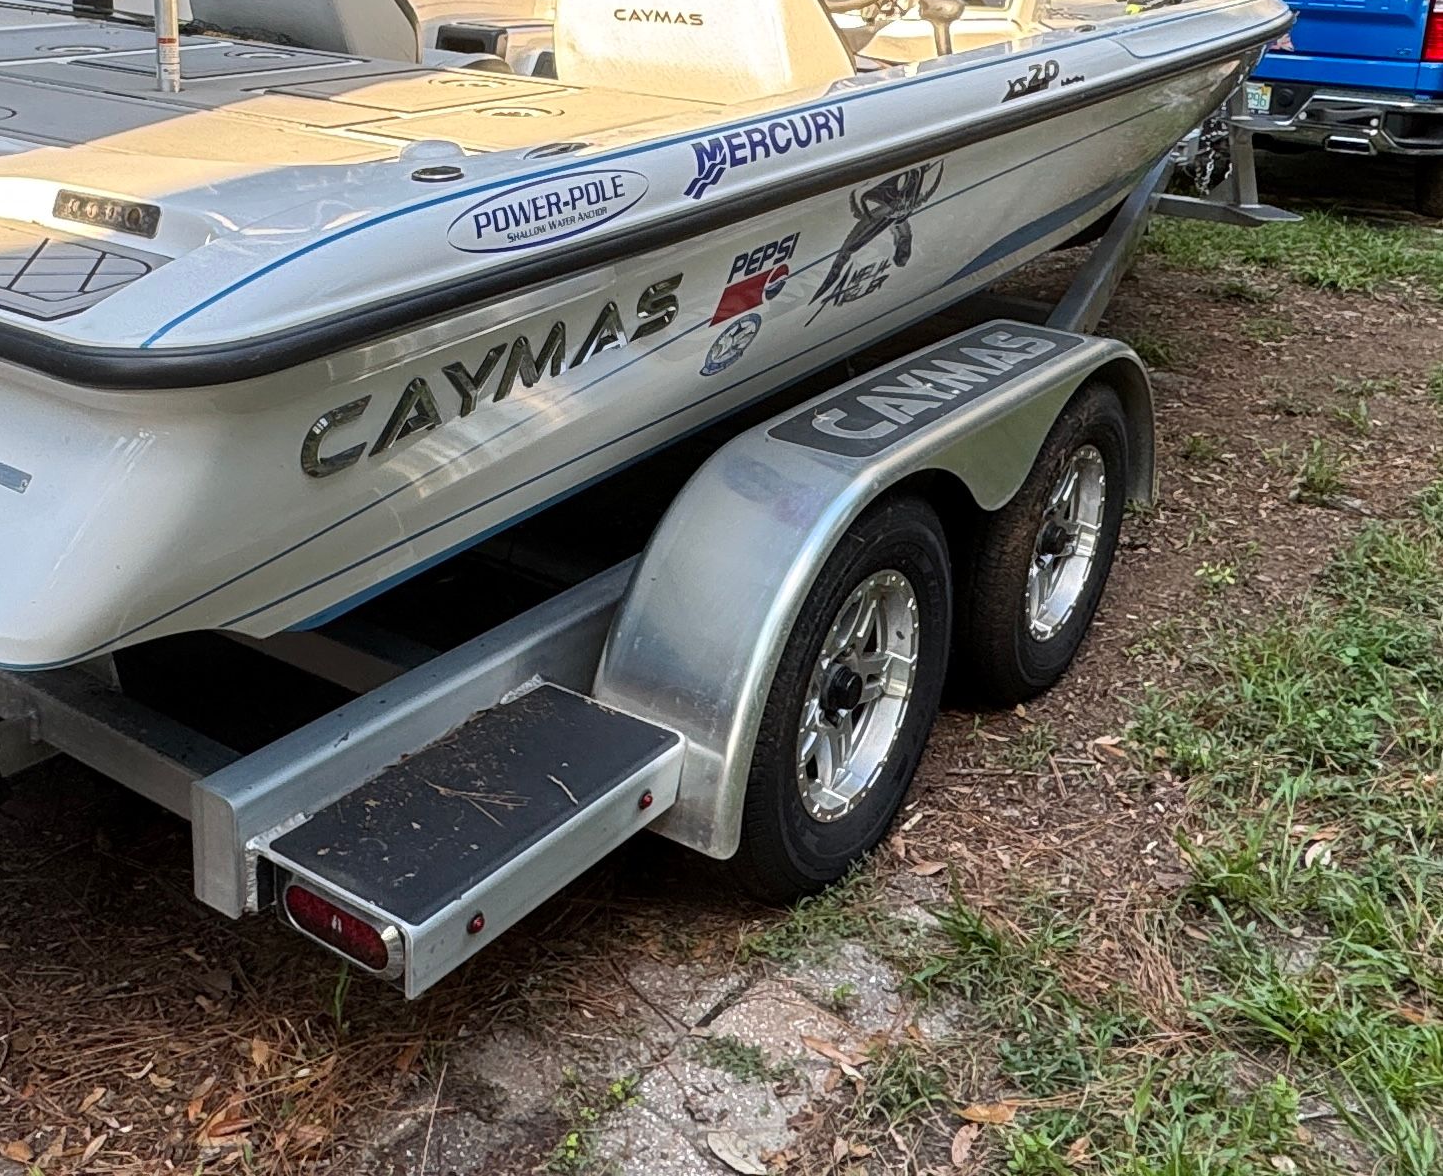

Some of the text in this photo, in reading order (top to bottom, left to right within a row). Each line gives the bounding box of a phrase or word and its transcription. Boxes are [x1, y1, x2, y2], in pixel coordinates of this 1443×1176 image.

[613, 8, 704, 26] CAYMAS
[683, 106, 845, 200] MERCURY
[472, 174, 626, 240] POWER-POLE
[727, 231, 801, 284] PEPSI
[300, 272, 684, 478] CAYMAS
[811, 330, 1057, 440] CAYMAS
